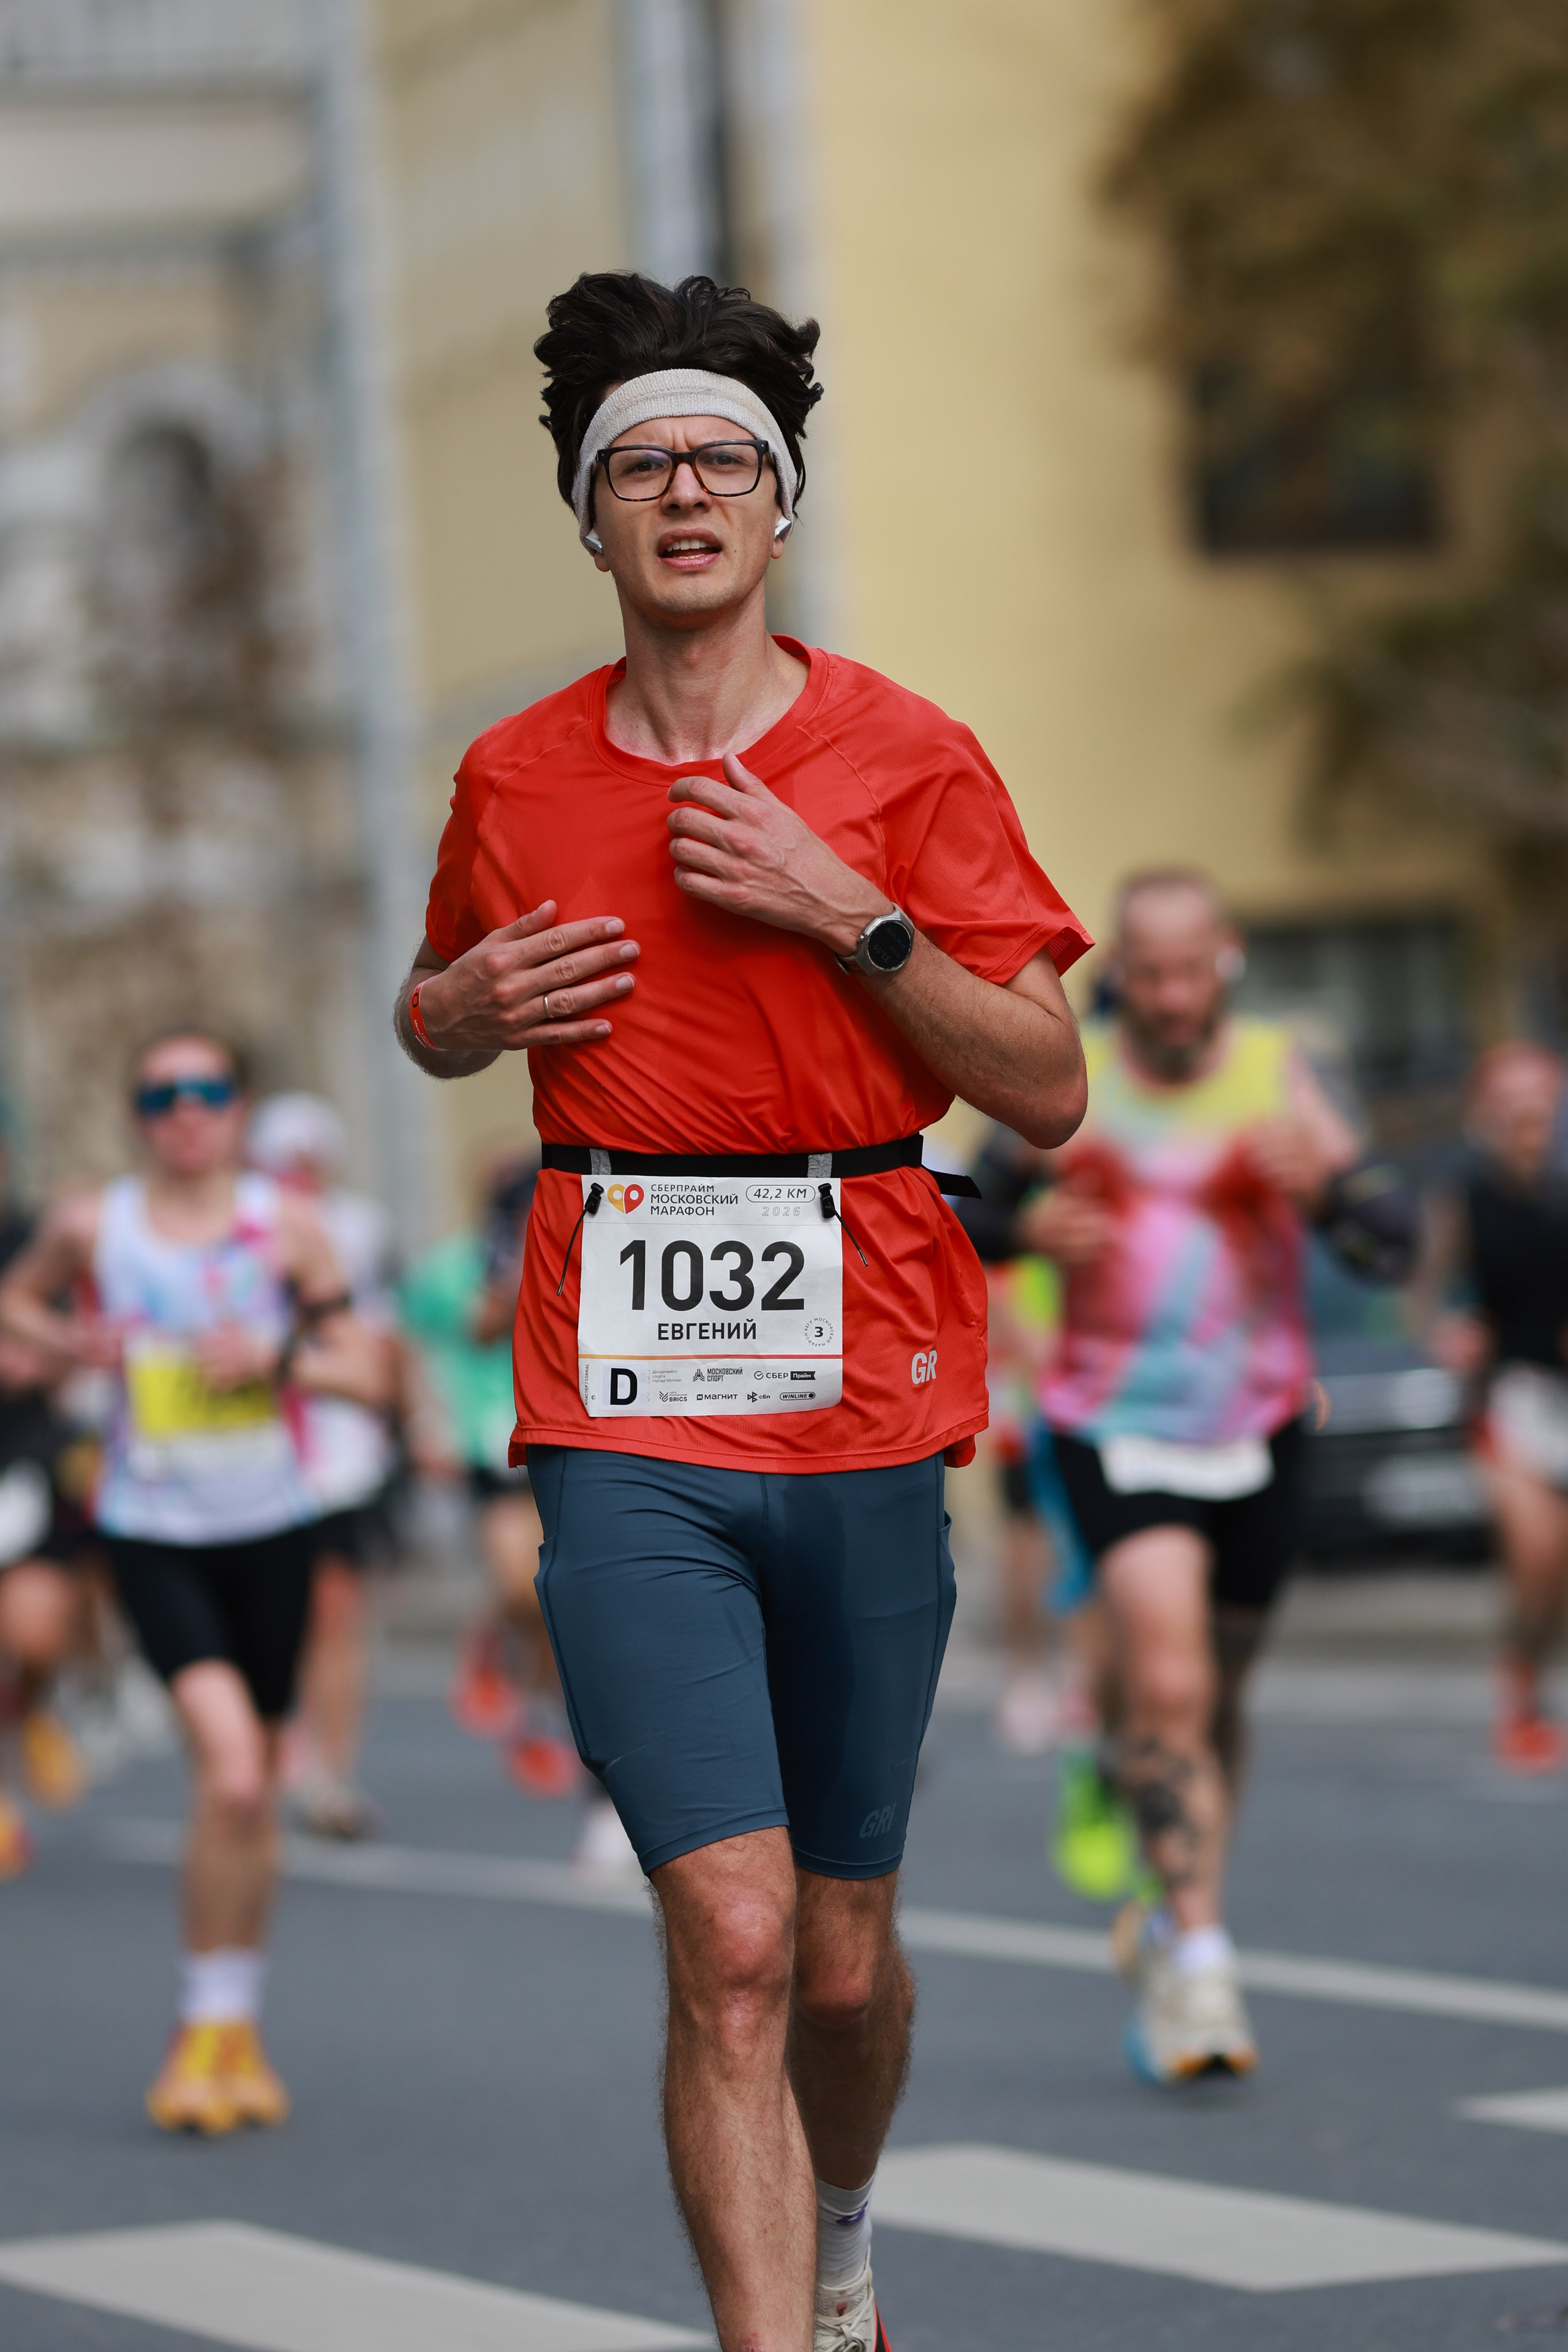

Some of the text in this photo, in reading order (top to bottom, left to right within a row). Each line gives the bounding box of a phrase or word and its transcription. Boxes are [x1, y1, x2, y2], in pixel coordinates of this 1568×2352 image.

[650, 1183, 715, 1193] СБЕРПРАЙМ
[753, 1188, 807, 1200] 42,2 КМ
[650, 1193, 739, 1205] МОСКОВСКИЙ
[650, 1205, 715, 1216] МАРАФОН
[761, 1206, 801, 1216] 2026
[620, 1239, 805, 1311] 1032
[657, 1318, 756, 1340] ЕВГЕНИЙ
[814, 1317, 834, 1343] МОСКОВСКИЙ
[814, 1326, 824, 1338] 3
[804, 1333, 826, 1347] МАРАФОН
[610, 1368, 638, 1406] D
